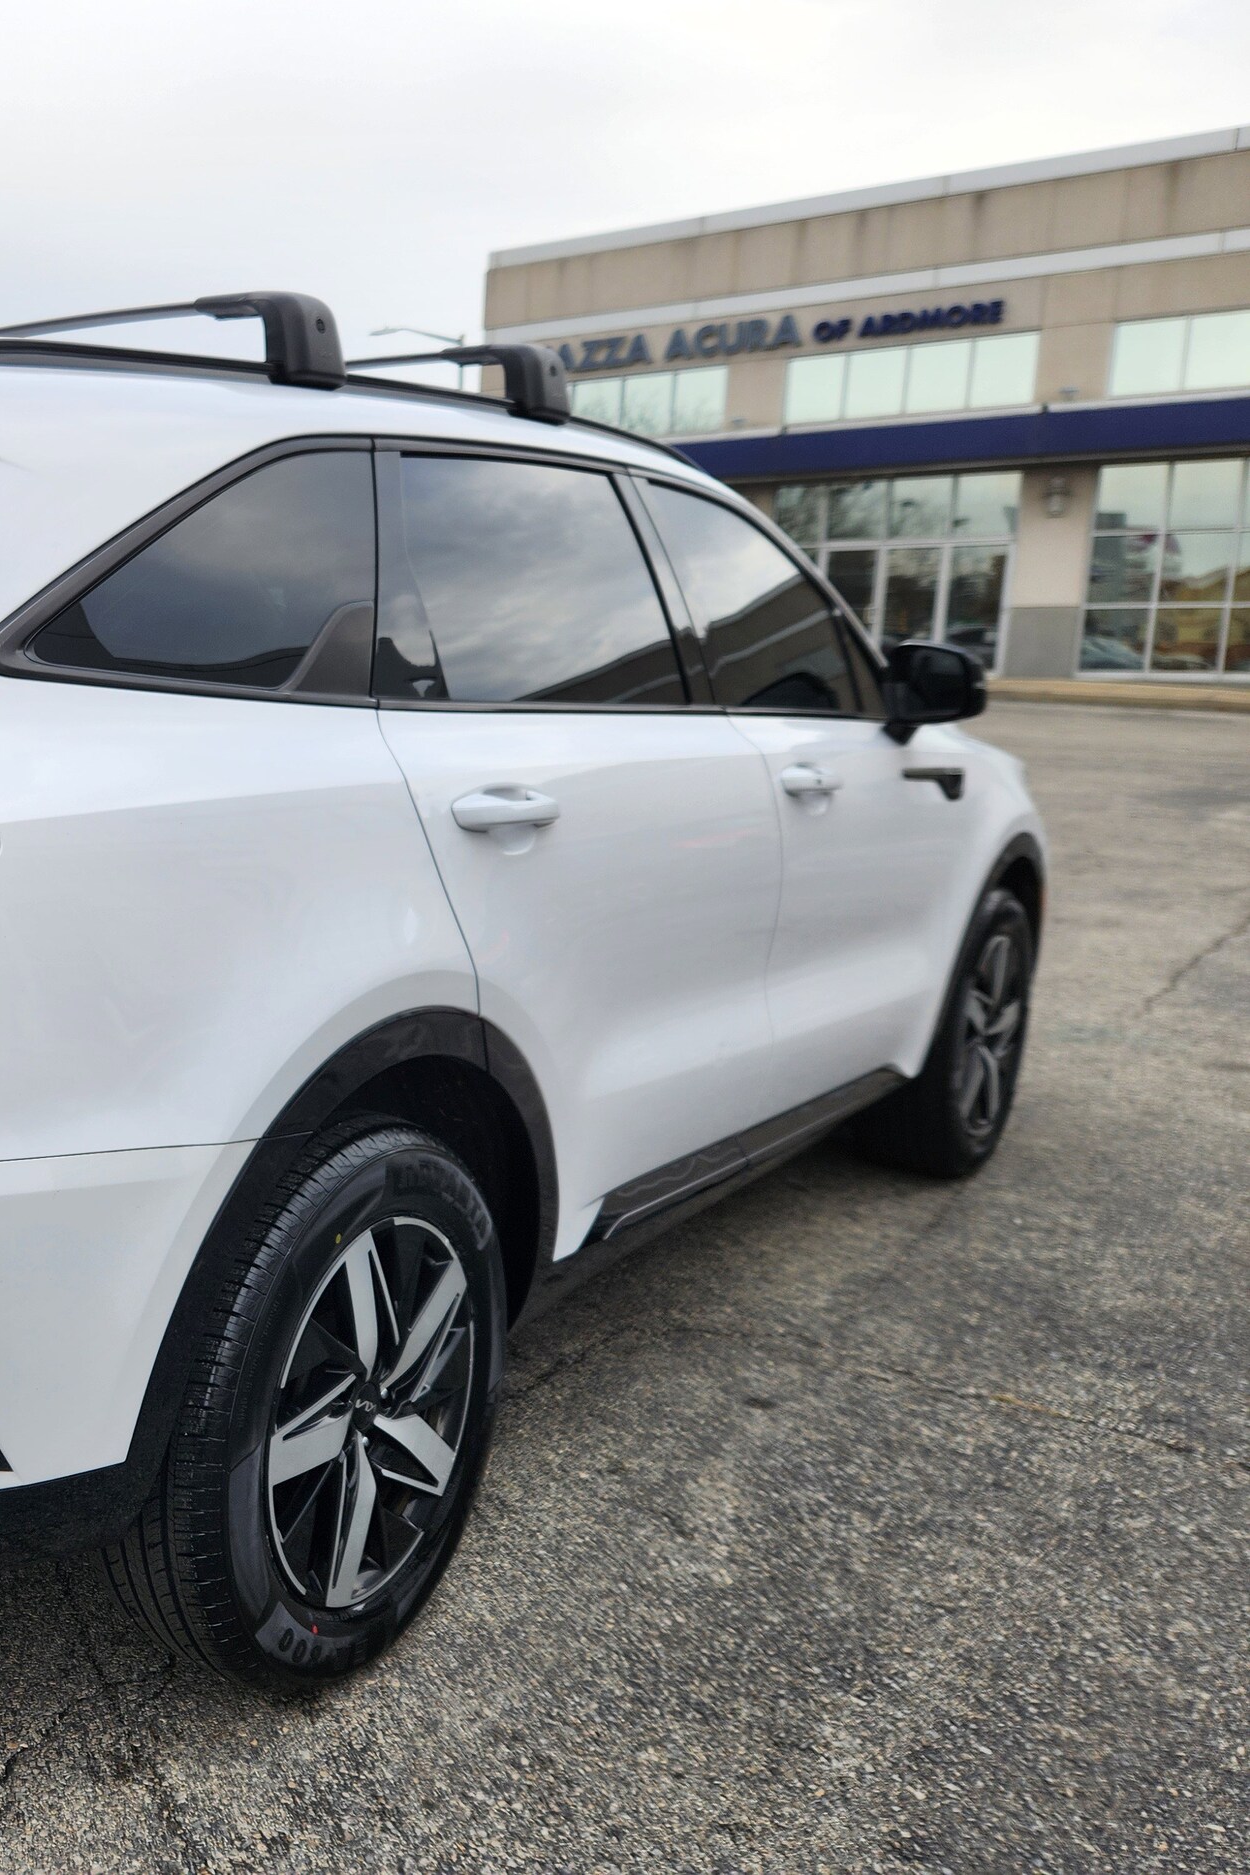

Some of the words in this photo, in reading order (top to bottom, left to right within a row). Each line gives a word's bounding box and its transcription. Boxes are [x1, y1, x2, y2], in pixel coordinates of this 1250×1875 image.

[664, 314, 802, 363] ACURA
[813, 318, 852, 343] OF
[858, 299, 1005, 338] ARDMORE
